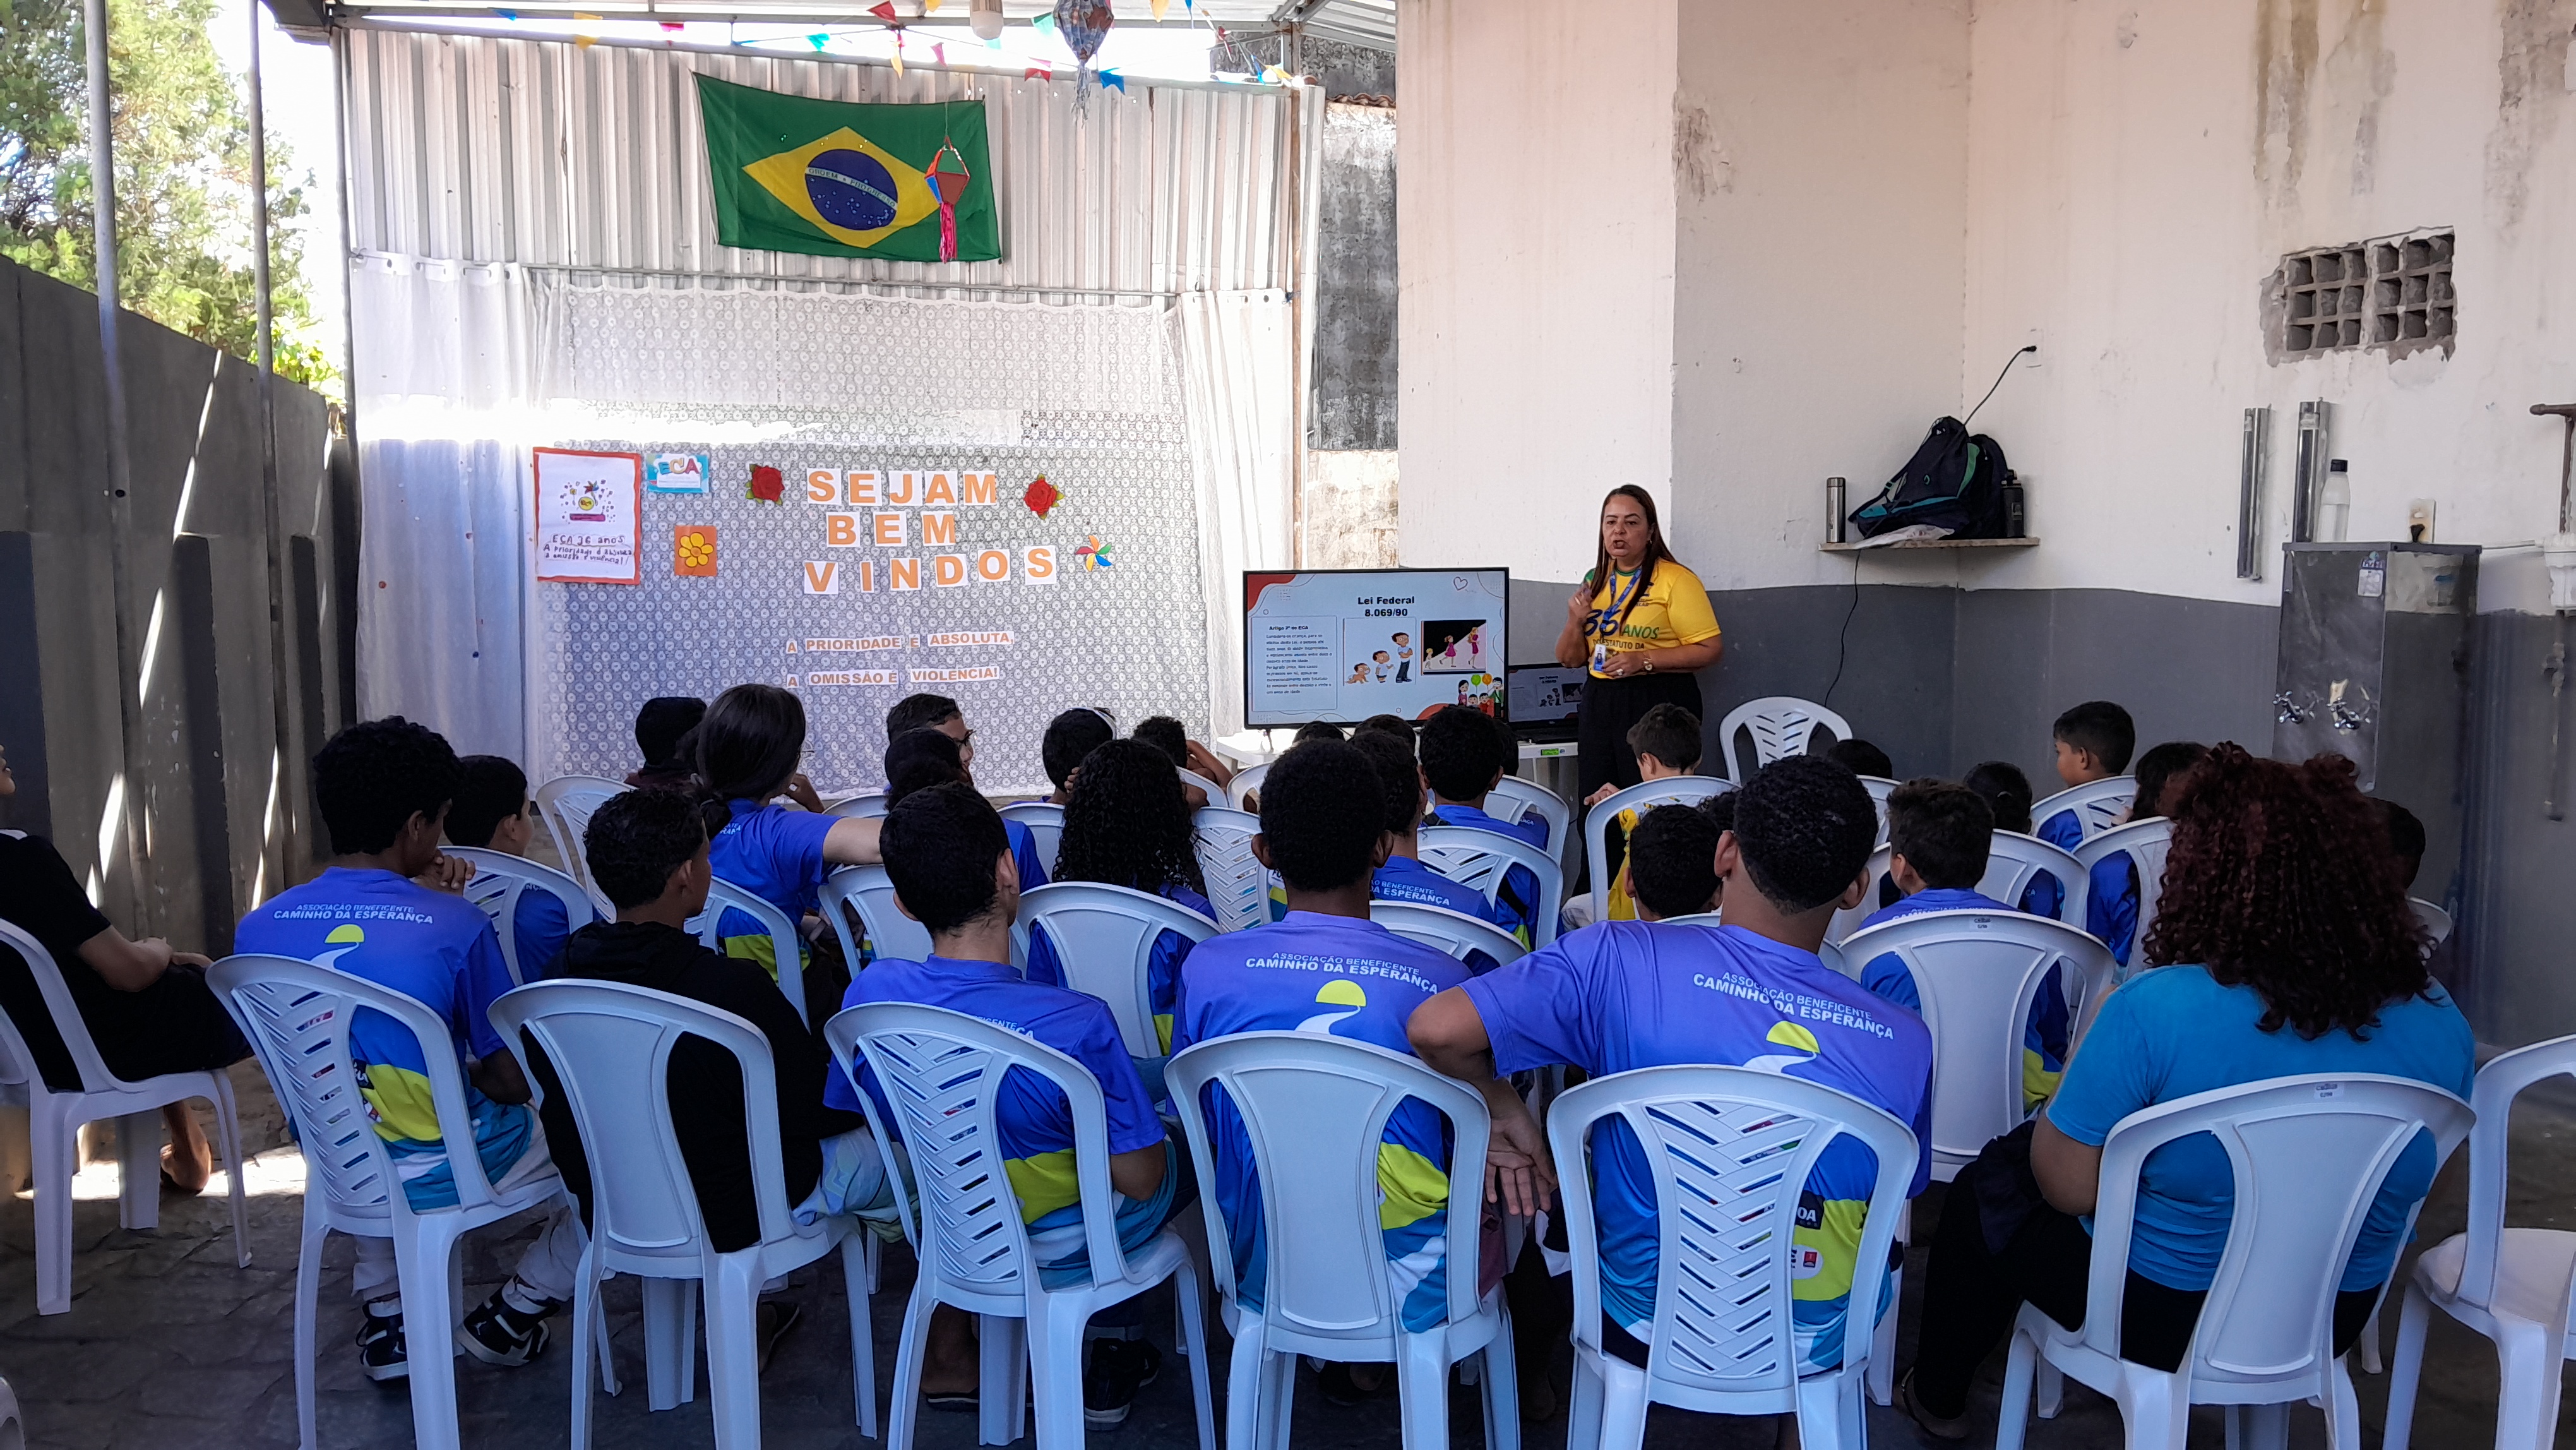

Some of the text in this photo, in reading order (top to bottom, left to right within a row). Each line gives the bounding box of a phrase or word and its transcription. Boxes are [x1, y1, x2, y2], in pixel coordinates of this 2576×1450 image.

[658, 458, 700, 475] ECA
[808, 470, 996, 503] SEJAM
[828, 514, 955, 544] BEM
[552, 534, 573, 544] ECA
[804, 548, 1052, 592] VINDOS
[1358, 596, 1415, 605] Lei Federal
[1364, 609, 1409, 618] 8.069/90
[1621, 624, 1660, 639] ANOS
[787, 633, 1014, 652] A PRIORIDADE É ABSOLUTA,
[1603, 639, 1633, 649] ESTATUTO
[788, 669, 998, 687] A OMISSÃO É VIOLENCIA!
[1381, 881, 1434, 895] BENEFICENTE
[1383, 887, 1450, 906] ESPERANÇA
[273, 910, 434, 924] CAMINHO DA ESPERANÇA
[296, 903, 415, 913] ASSOCIAÇÃO BENEFICENTE
[1272, 952, 1420, 975] ASSOCIAÇÃO BENEFICENTE
[1246, 958, 1438, 994] CAMINHO DA ESPERANÇA
[1722, 972, 1873, 1021] ASSOCIAÇÃO BENEFICENTE
[1693, 973, 1894, 1040] CAMINHO DA ESPERANÇA
